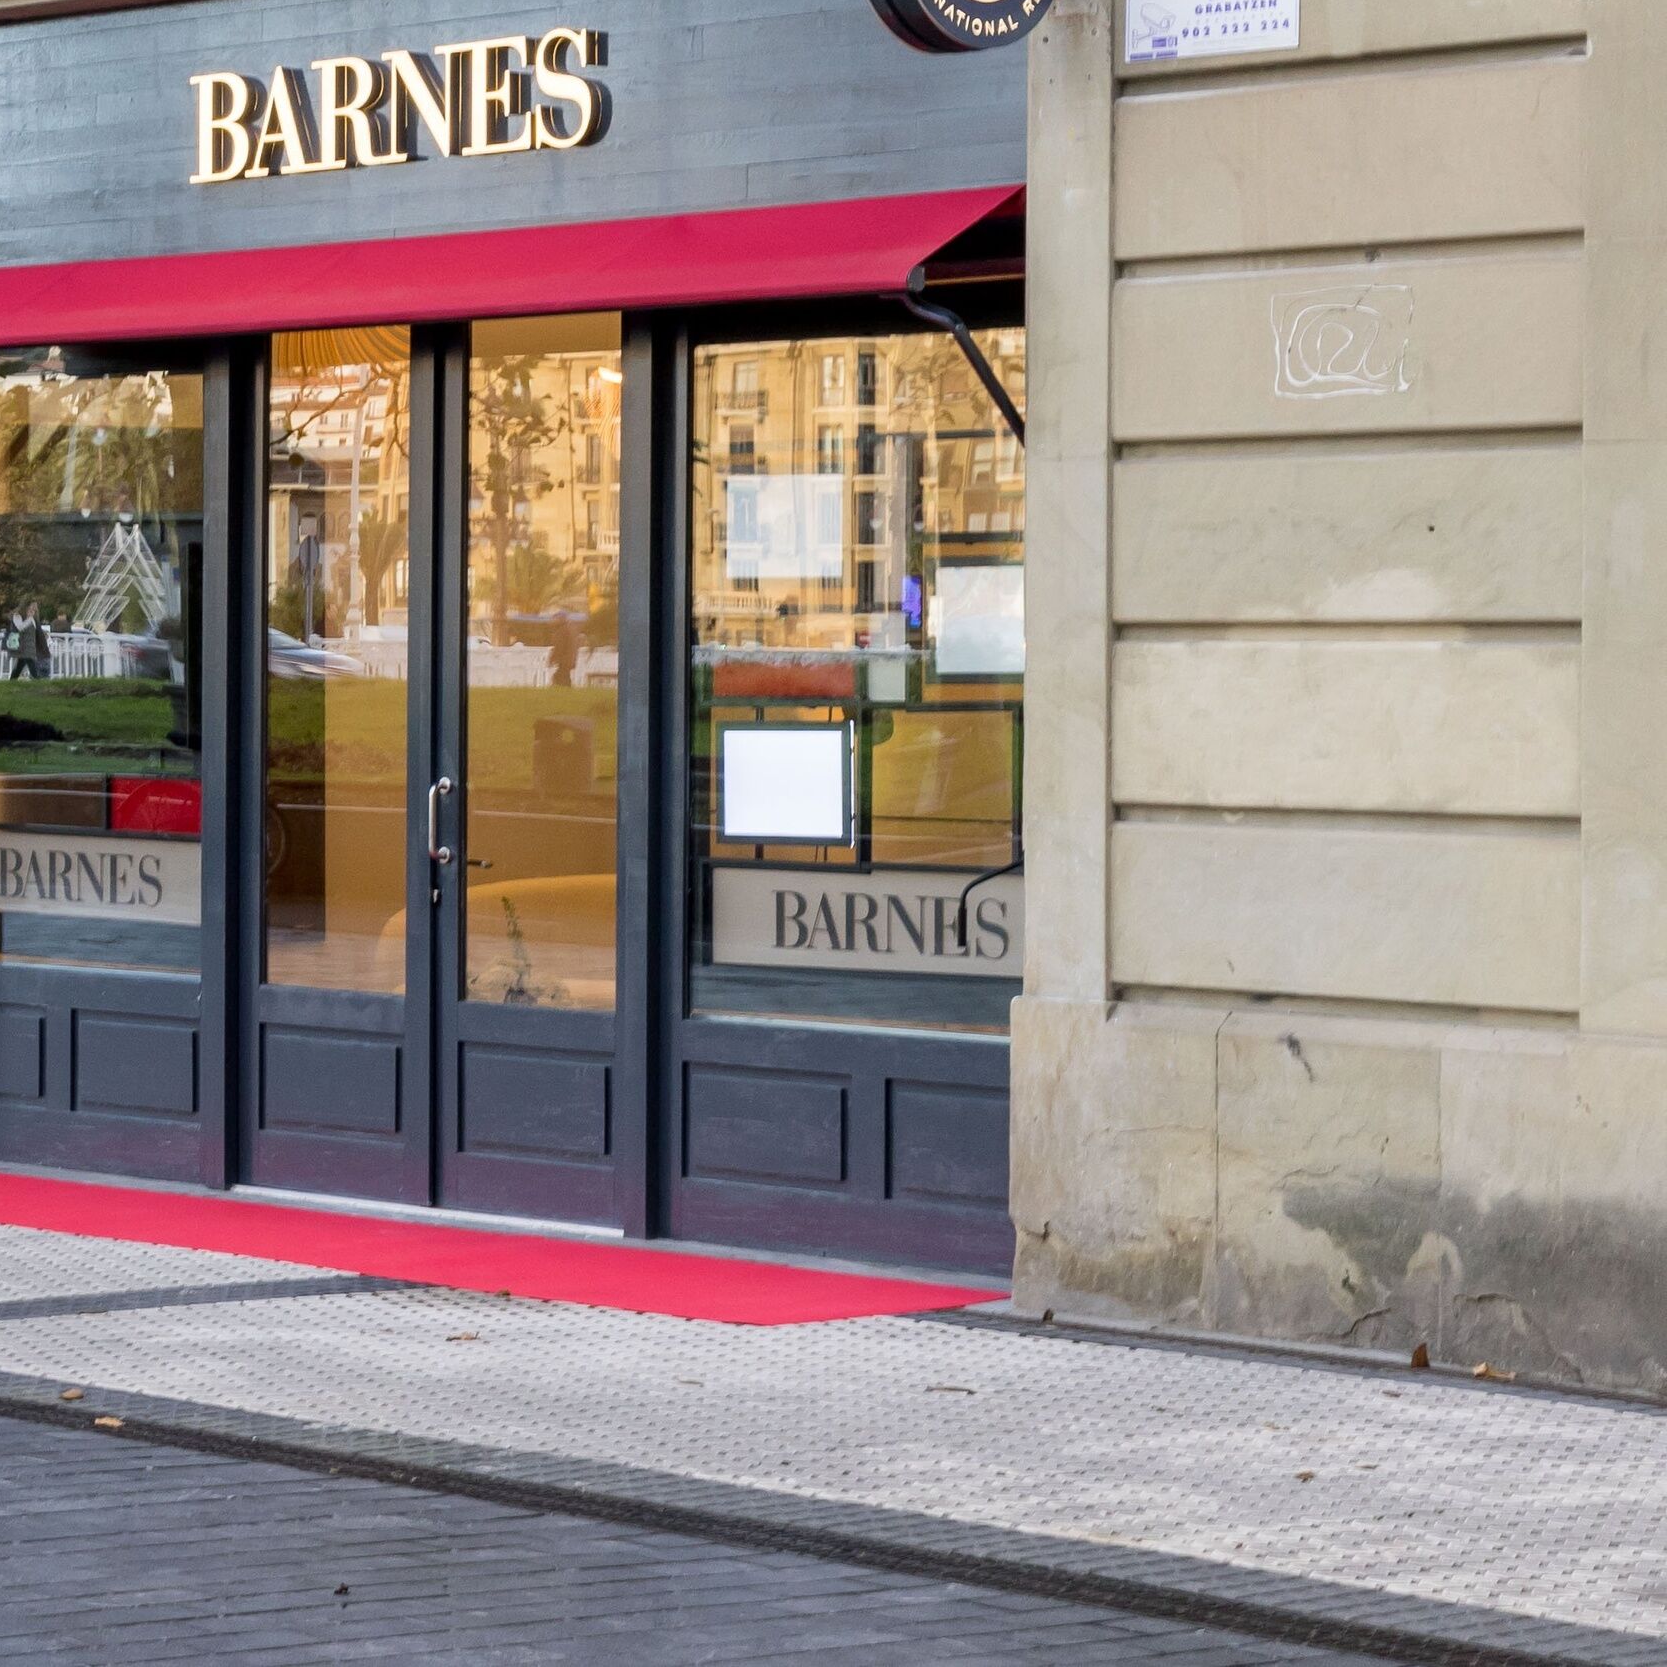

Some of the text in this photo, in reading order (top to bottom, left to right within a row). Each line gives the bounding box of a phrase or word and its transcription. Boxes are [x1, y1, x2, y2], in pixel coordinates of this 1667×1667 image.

[1181, 26, 1211, 39] 902
[189, 27, 597, 185] BARNES
[771, 890, 1009, 960] BARNES
